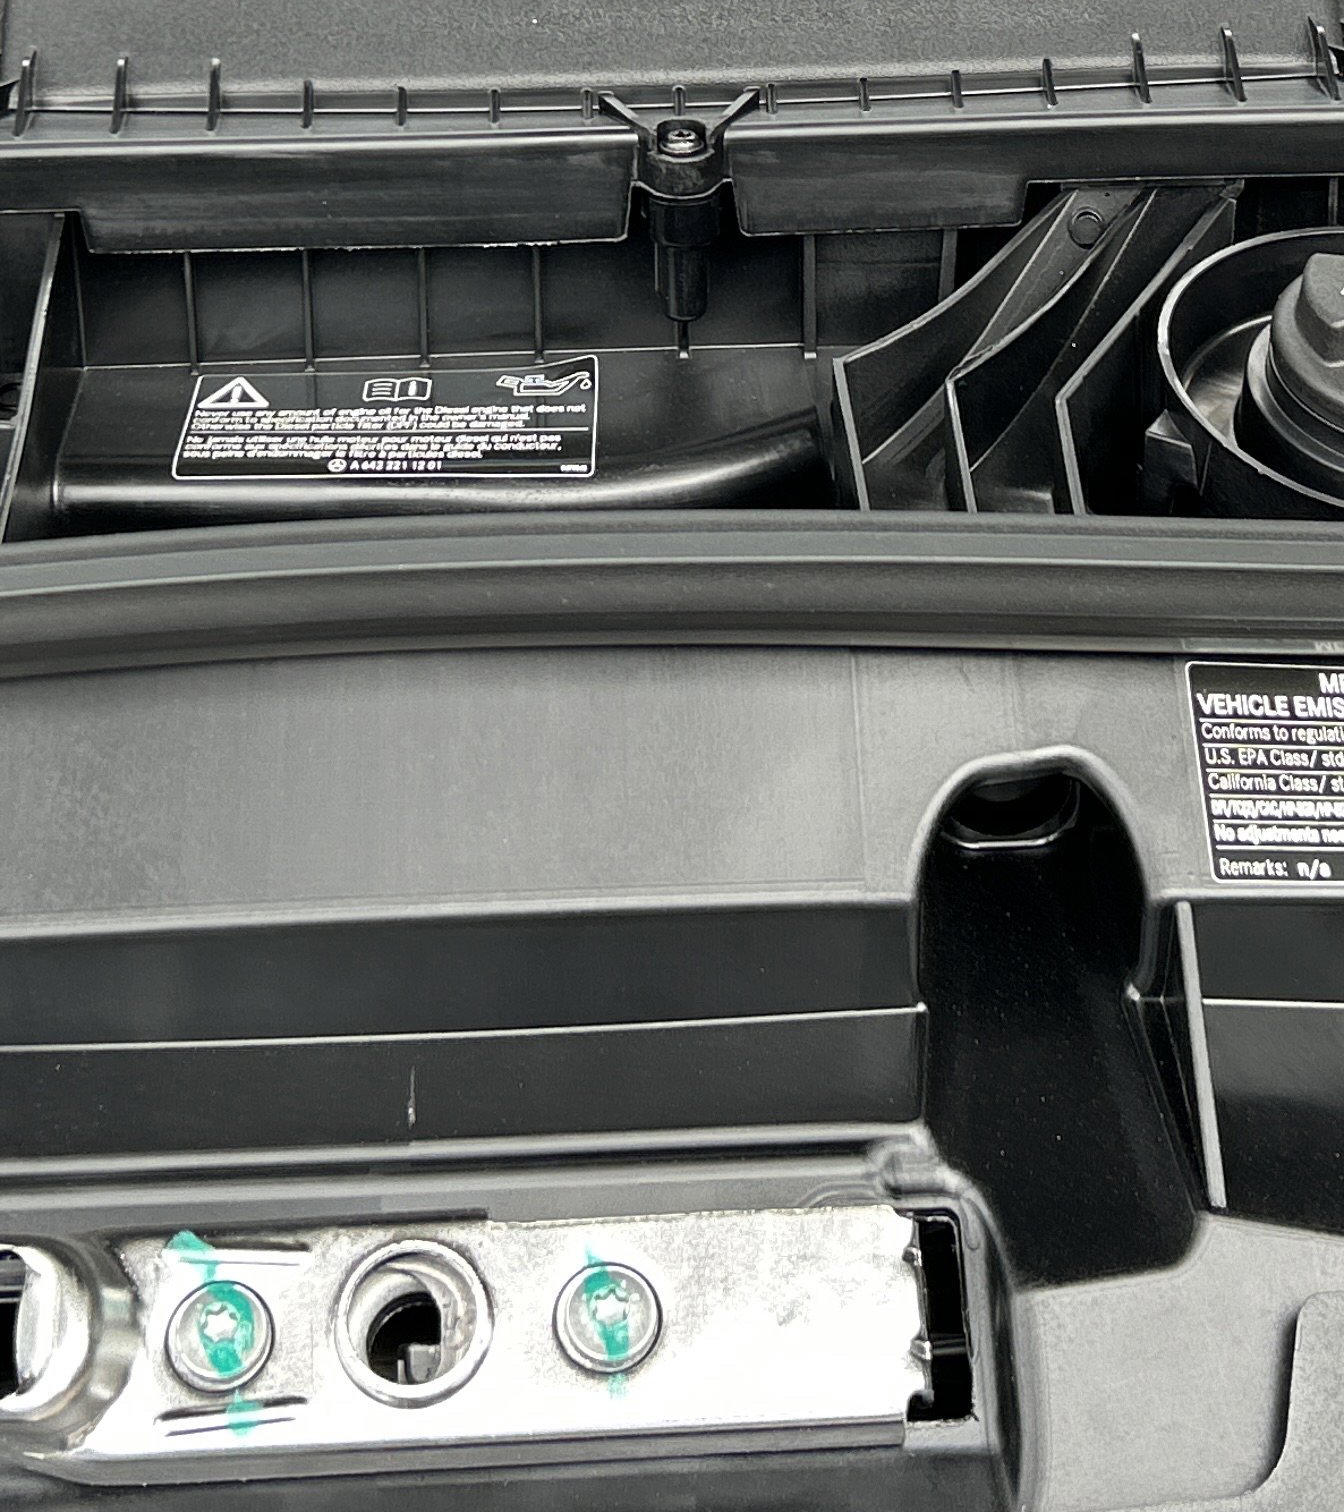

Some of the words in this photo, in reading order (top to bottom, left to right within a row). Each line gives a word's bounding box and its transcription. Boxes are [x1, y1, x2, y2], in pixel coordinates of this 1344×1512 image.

[349, 460, 360, 470] A
[360, 459, 384, 470] 642
[385, 459, 407, 470] 221
[411, 459, 426, 470] 12
[426, 459, 442, 470] 01
[1196, 692, 1289, 717] VEHICLE
[1200, 720, 1271, 740] Conforms
[1272, 723, 1289, 741] to
[1212, 822, 1236, 841] No
[1236, 823, 1320, 845] adjustments
[1218, 857, 1288, 876] Remarks:
[1296, 858, 1331, 879] n/a
